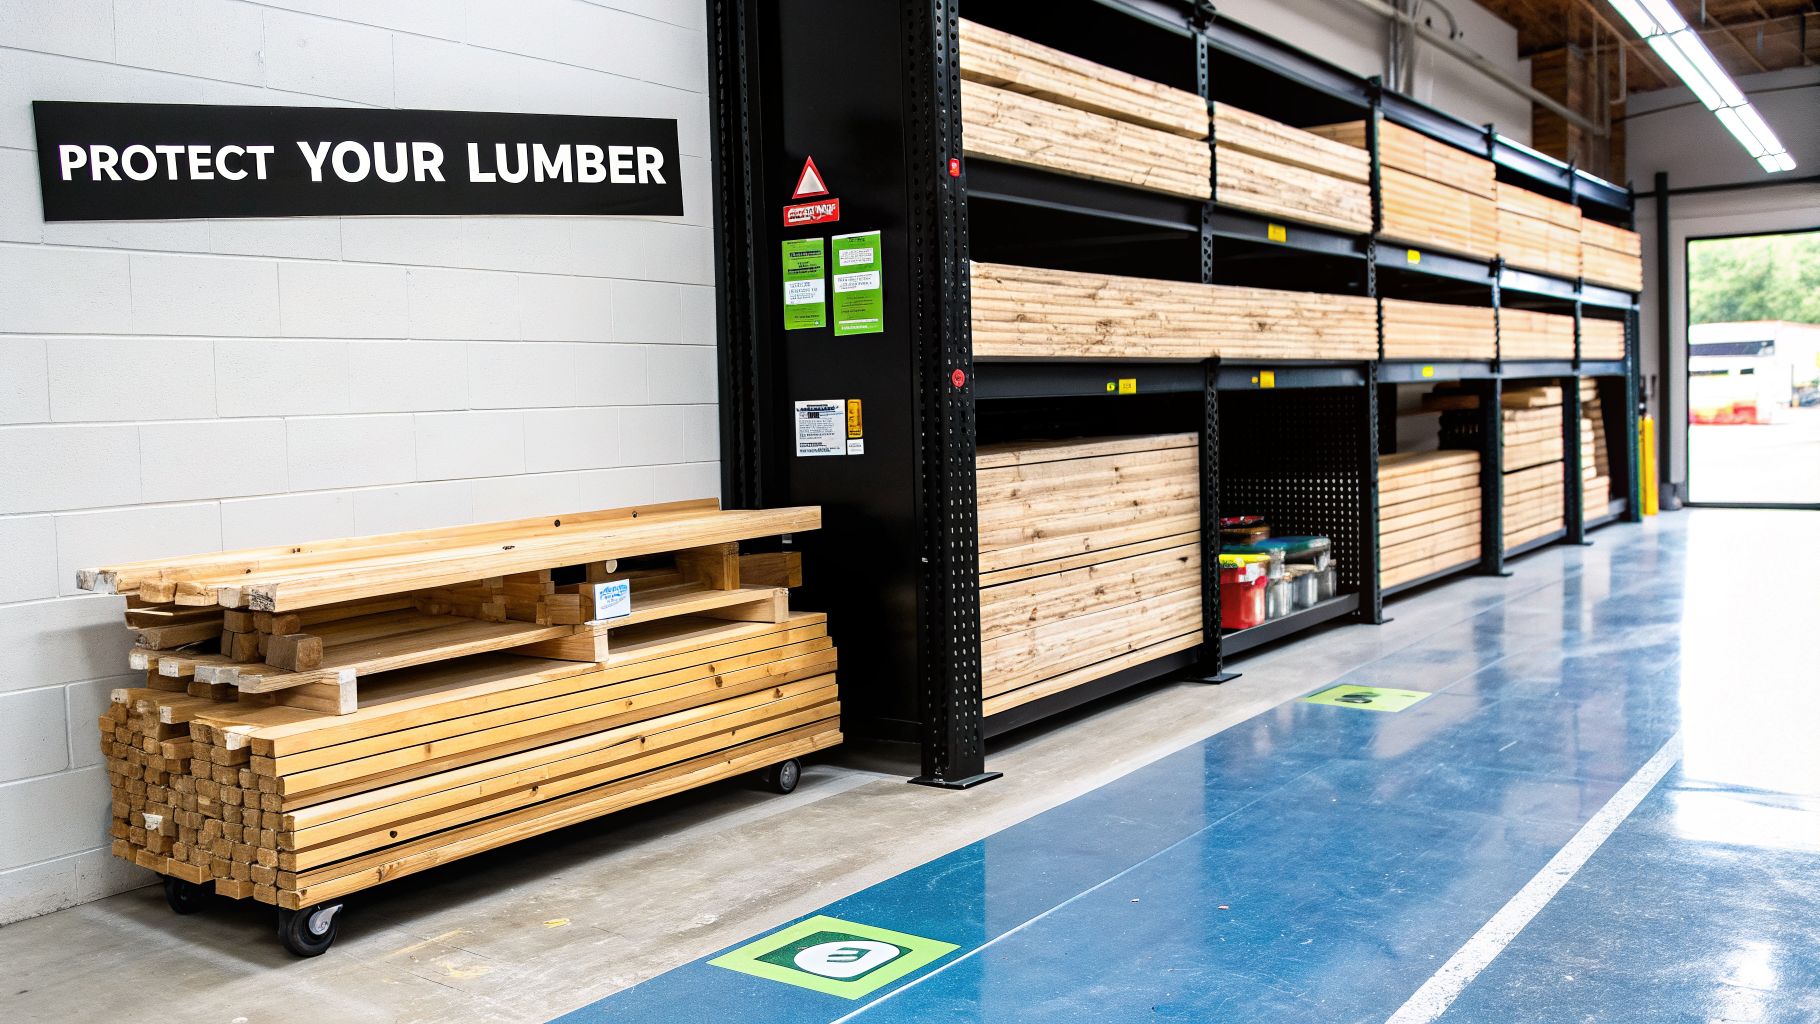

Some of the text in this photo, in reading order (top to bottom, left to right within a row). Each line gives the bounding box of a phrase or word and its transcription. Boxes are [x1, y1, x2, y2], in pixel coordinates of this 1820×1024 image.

[59, 141, 667, 185] PROTECT YOUR LUMBER
